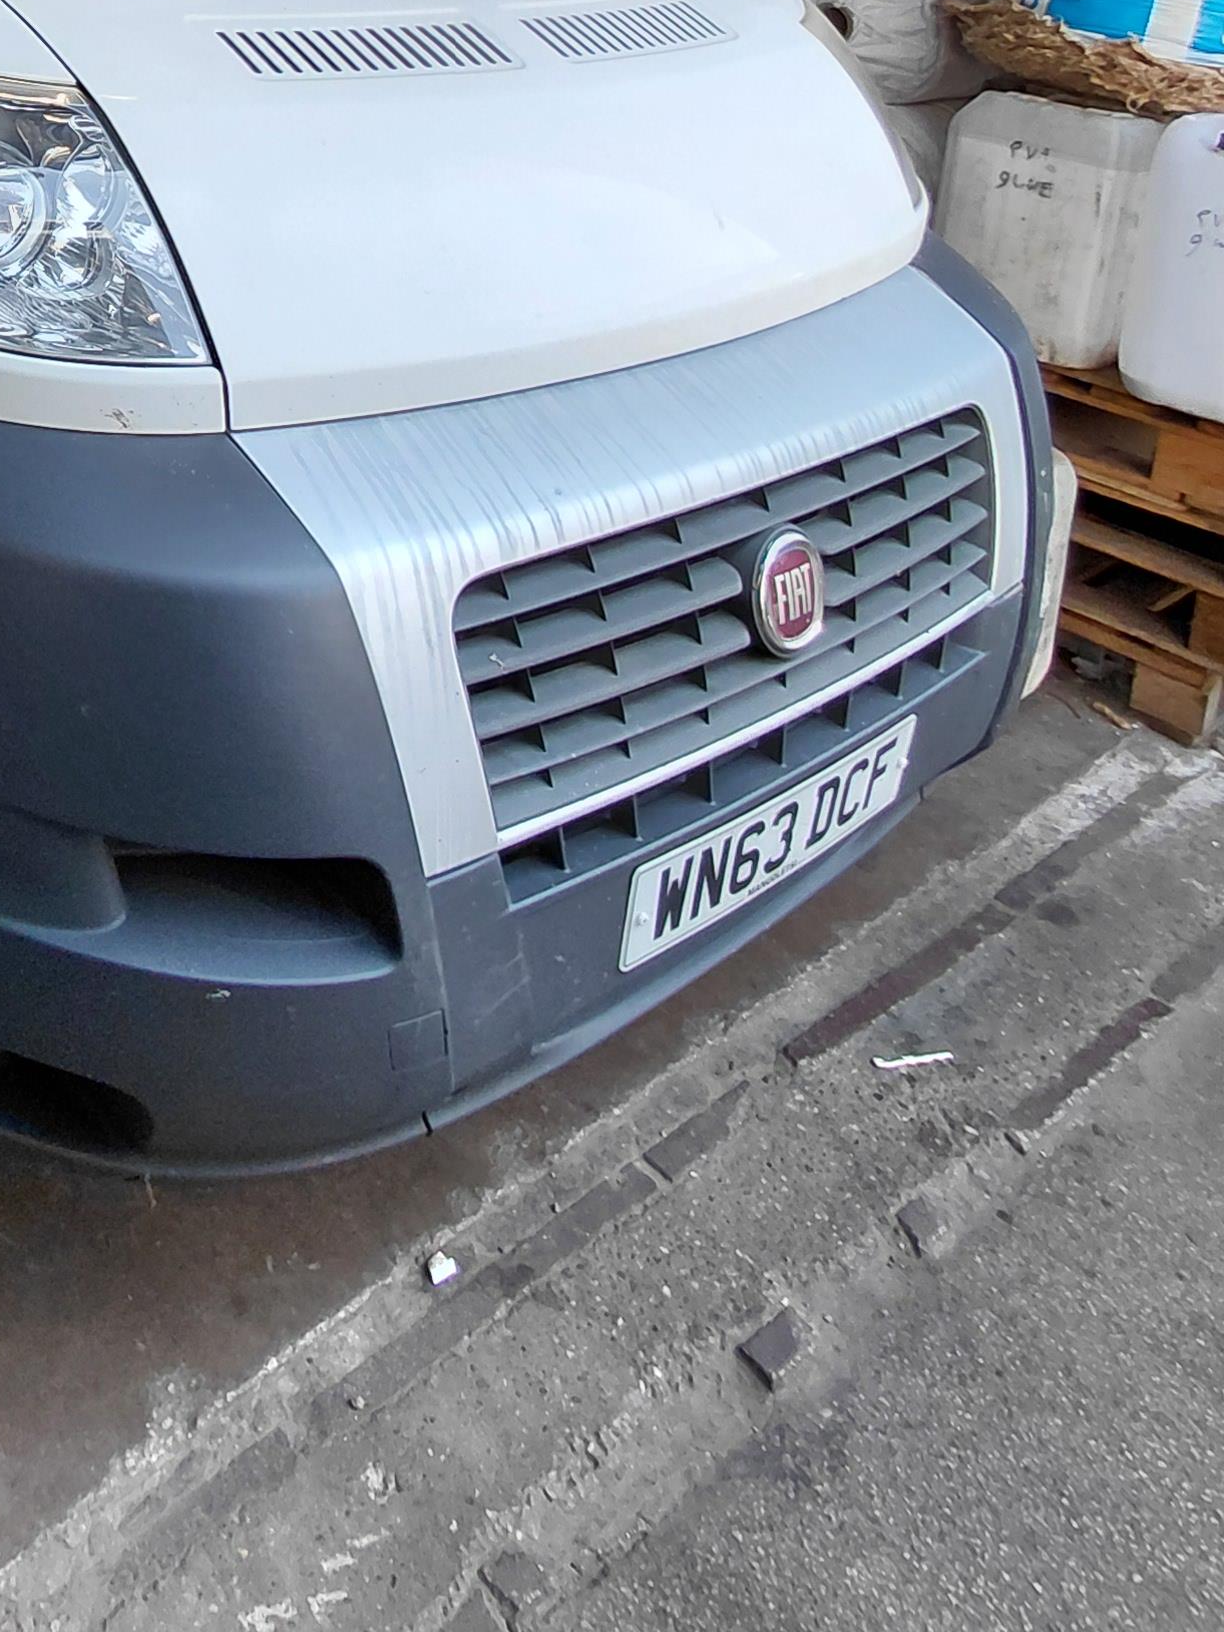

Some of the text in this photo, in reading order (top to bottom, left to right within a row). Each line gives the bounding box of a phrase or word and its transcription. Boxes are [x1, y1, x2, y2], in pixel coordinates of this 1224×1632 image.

[774, 562, 812, 625] FIAT
[653, 737, 898, 940] WN63 DCF
